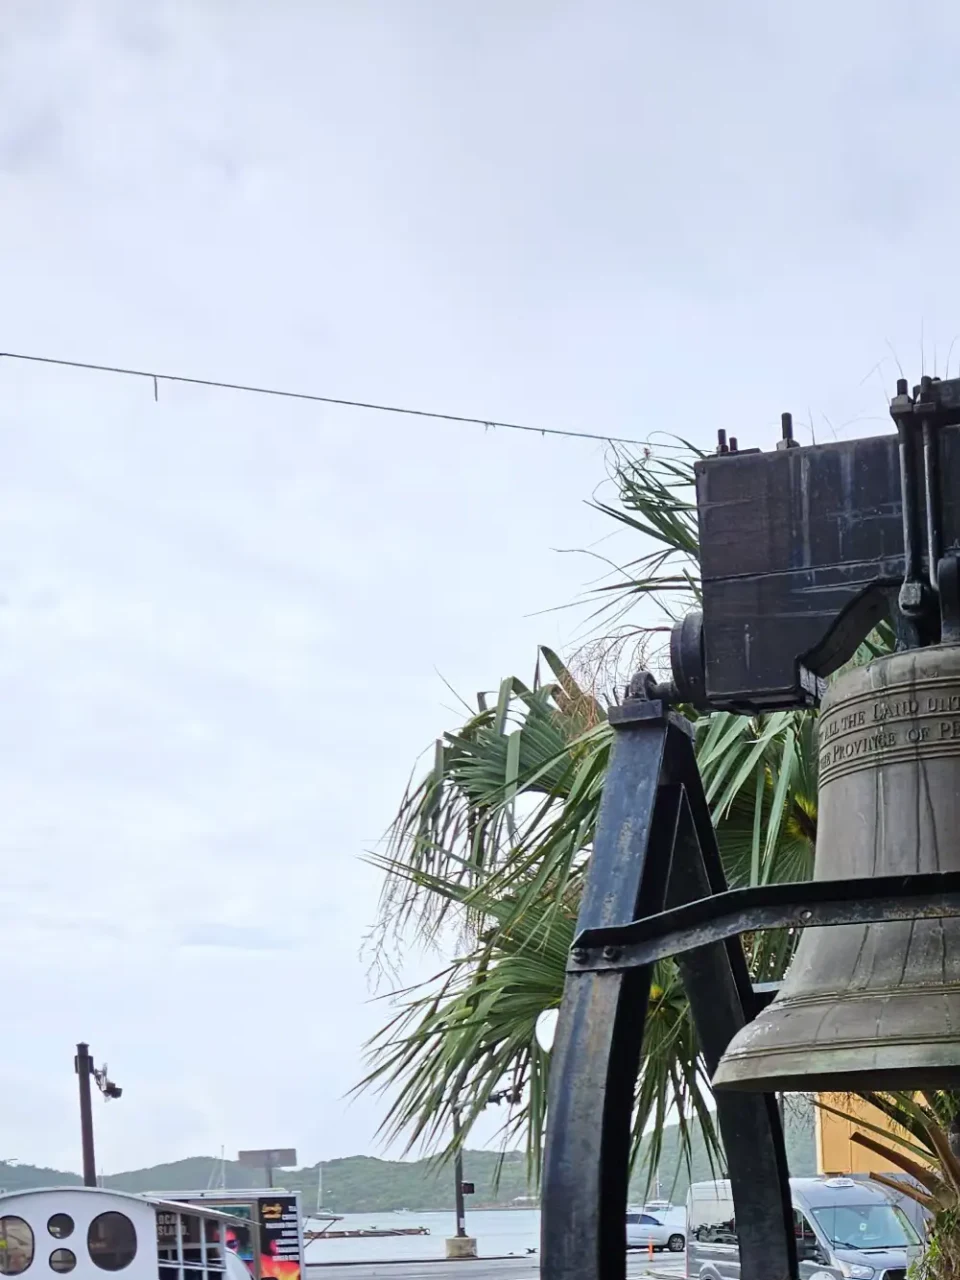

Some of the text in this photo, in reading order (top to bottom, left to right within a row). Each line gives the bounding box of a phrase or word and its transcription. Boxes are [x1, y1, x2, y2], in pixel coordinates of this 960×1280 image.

[823, 725, 839, 740] ALL
[841, 710, 865, 730] THE
[873, 701, 919, 720] LAND
[832, 731, 896, 763] PROVINCE
[908, 726, 930, 742] OF
